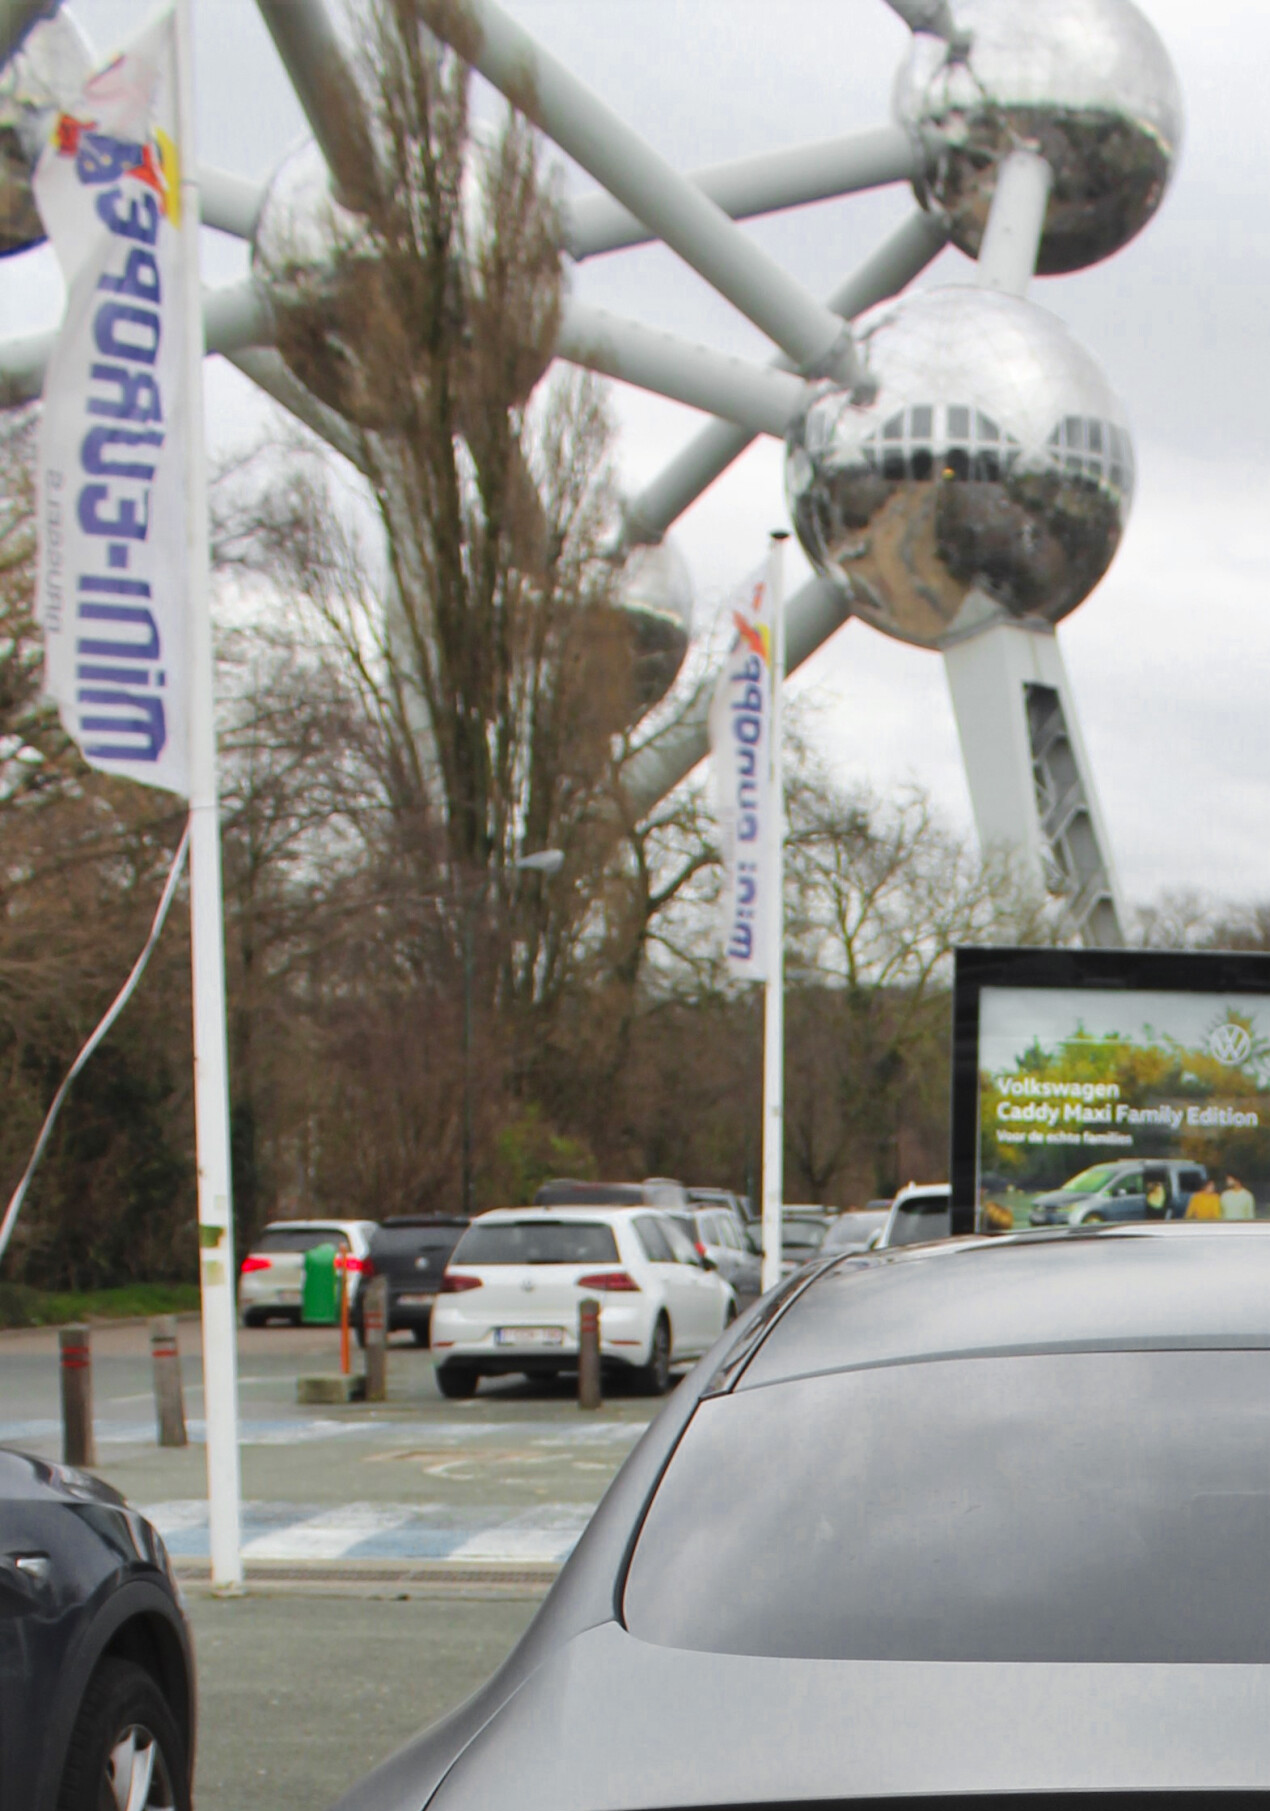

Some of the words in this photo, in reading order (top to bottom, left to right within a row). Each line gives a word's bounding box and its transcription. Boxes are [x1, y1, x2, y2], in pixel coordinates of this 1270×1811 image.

[998, 1077, 1120, 1102] Volkswagen
[997, 1101, 1059, 1126] Caddy
[1063, 1103, 1112, 1123] Maxi
[1116, 1104, 1183, 1129] Family
[1187, 1106, 1258, 1126] Edition
[997, 1129, 1026, 1143] Voor
[1028, 1130, 1044, 1144] de
